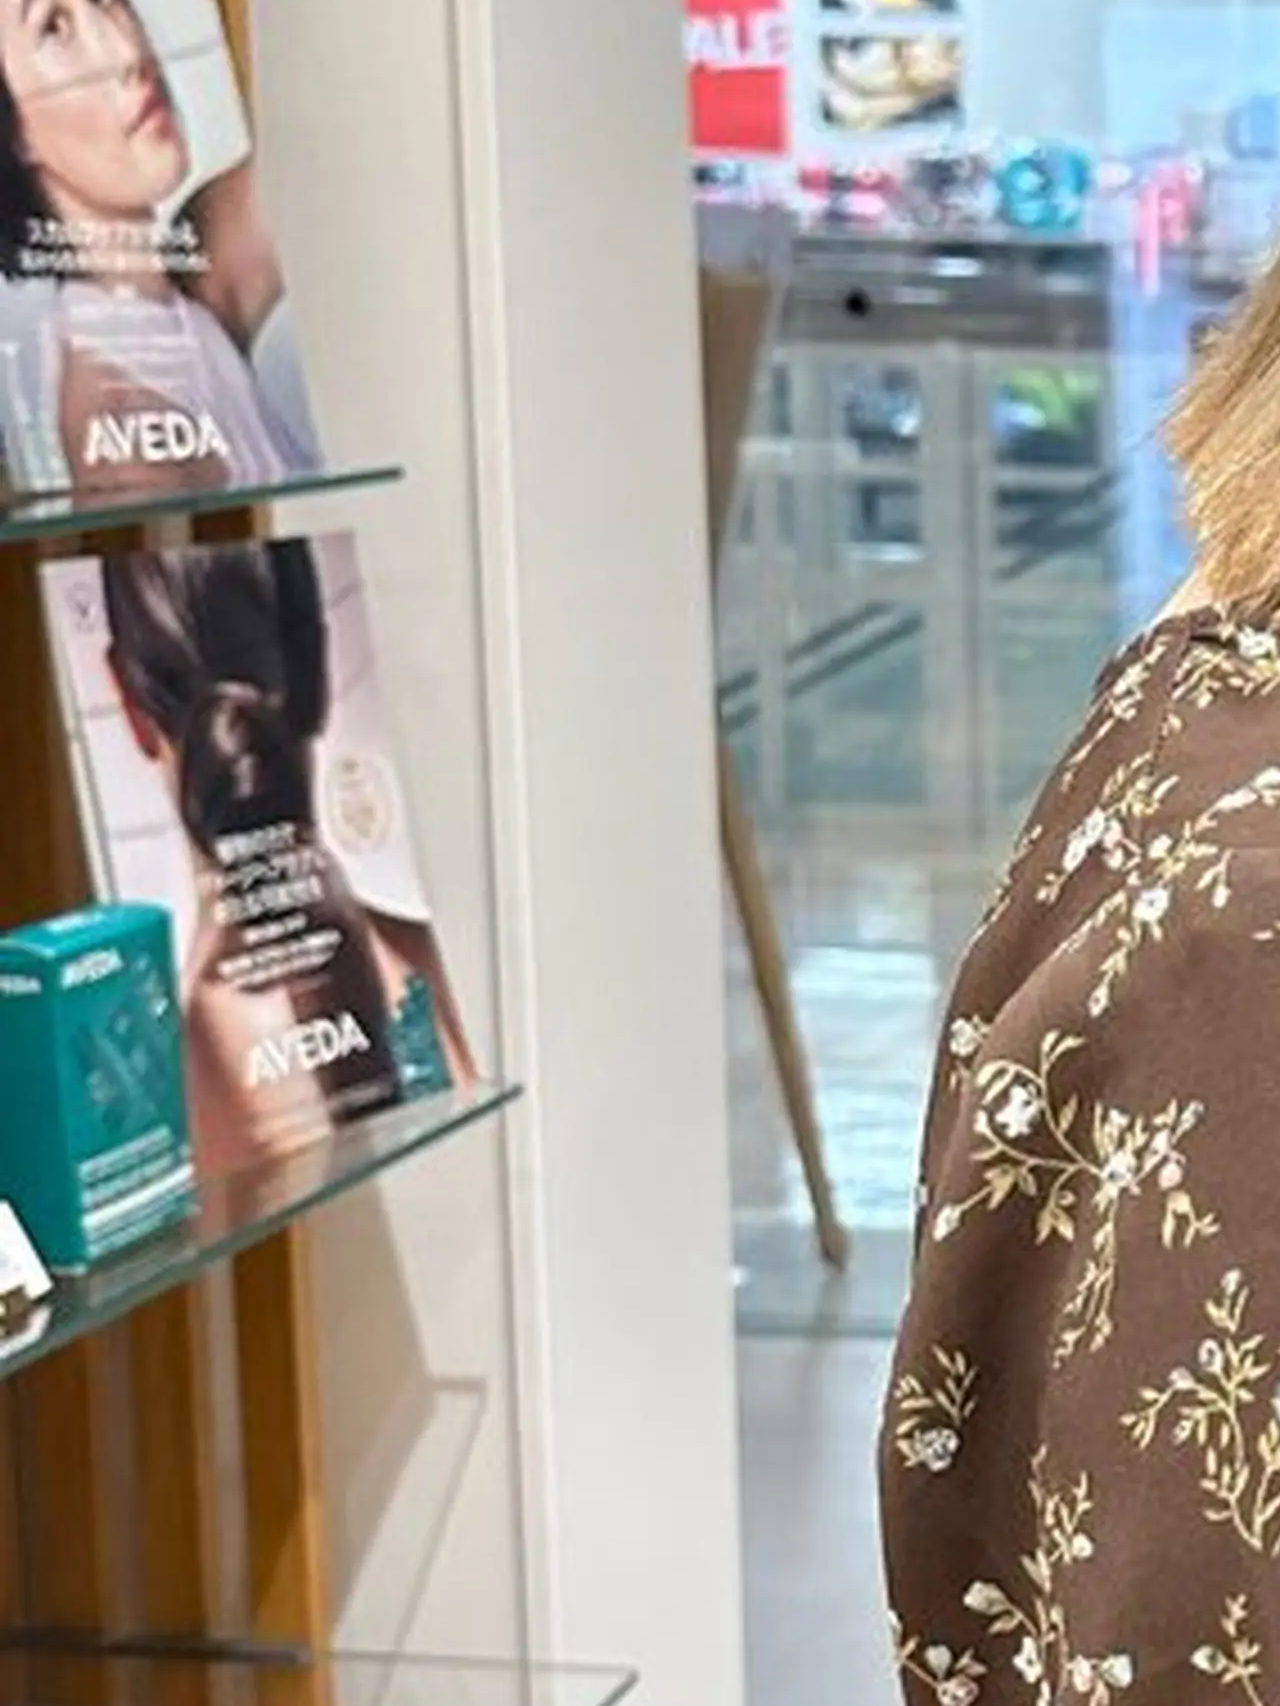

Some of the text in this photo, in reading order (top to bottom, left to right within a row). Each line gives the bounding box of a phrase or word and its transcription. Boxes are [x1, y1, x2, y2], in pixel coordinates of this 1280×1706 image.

[683, 11, 794, 67] ALE
[83, 412, 229, 466] AVEDA
[244, 1011, 371, 1089] AVEDA
